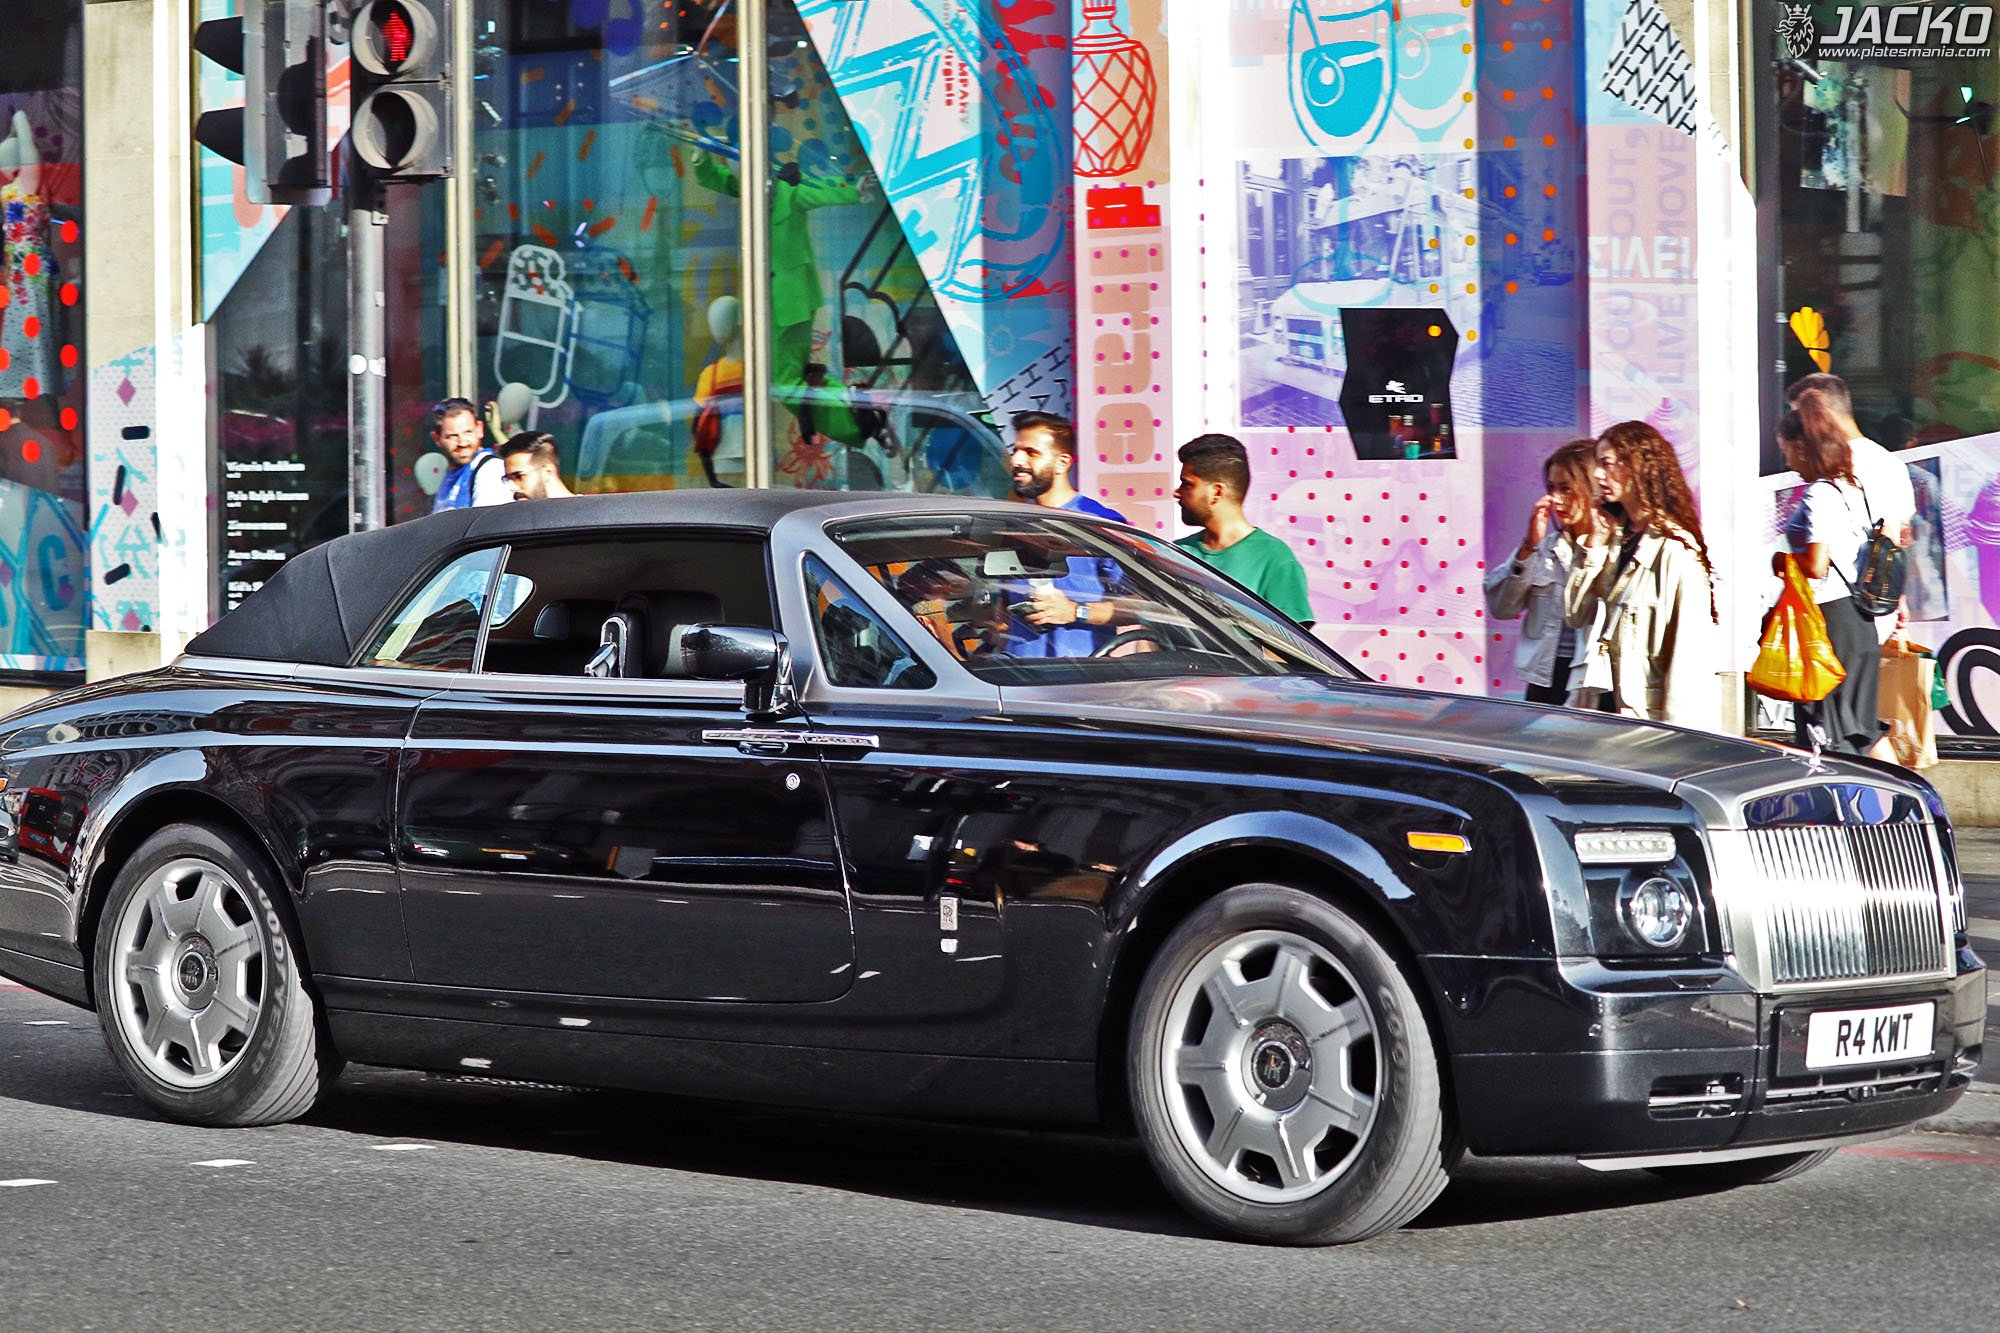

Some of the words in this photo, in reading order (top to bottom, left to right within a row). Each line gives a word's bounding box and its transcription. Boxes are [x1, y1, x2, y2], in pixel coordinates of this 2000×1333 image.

[1368, 394, 1424, 403] ETRO
[1836, 1018, 1866, 1057] R4
[1873, 1013, 1913, 1053] KWT
